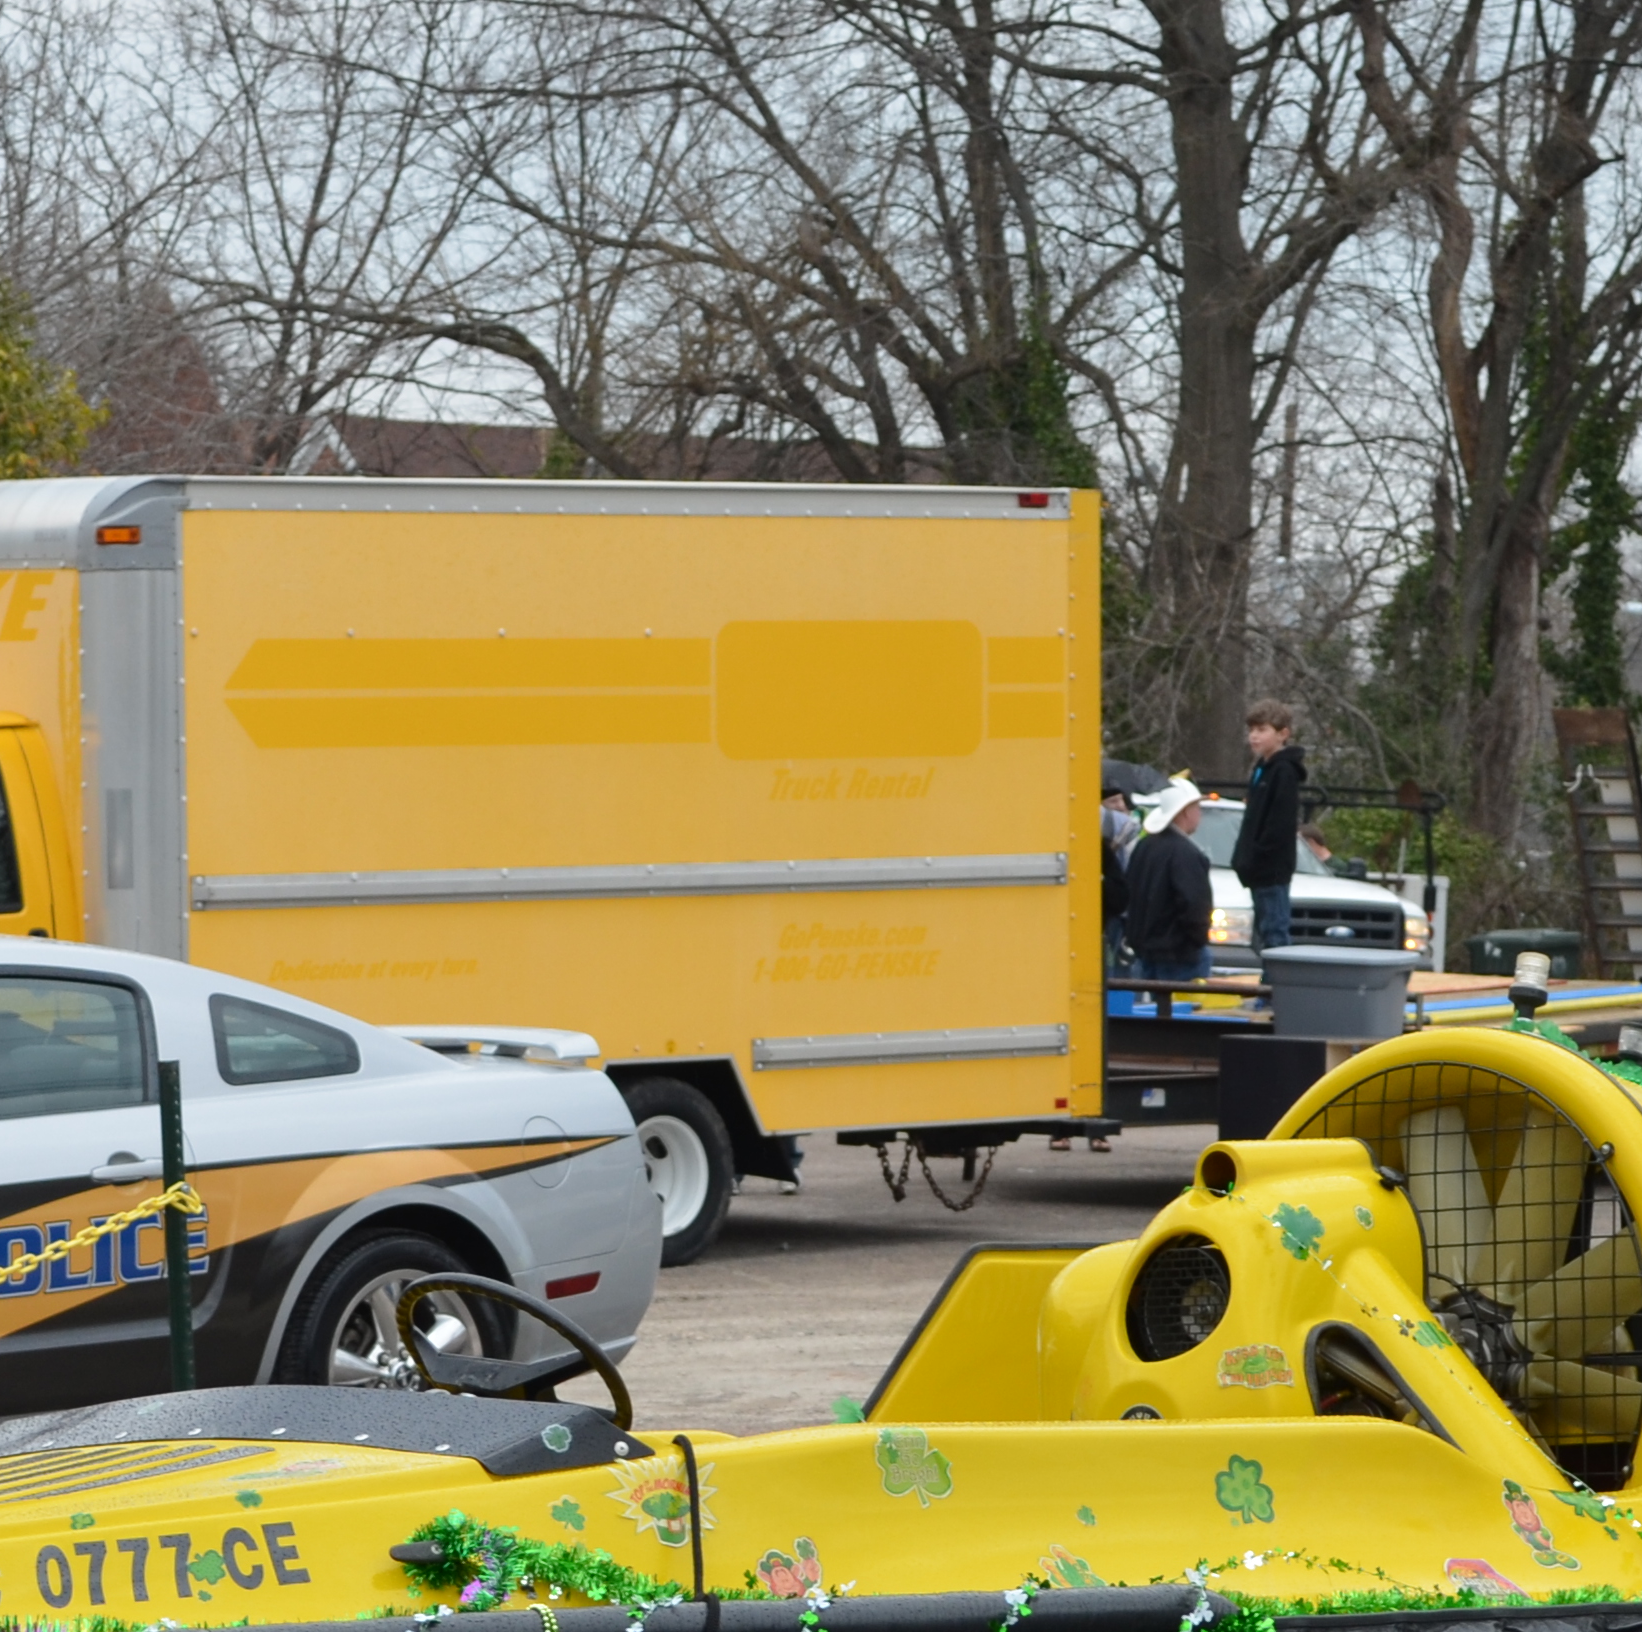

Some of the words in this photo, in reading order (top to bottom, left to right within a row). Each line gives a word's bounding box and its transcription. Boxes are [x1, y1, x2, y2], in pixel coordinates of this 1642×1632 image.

[769, 767, 845, 800] Truck
[846, 766, 937, 800] Rental
[778, 919, 928, 951] GoPenske.com
[35, 1533, 195, 1609] 0777
[222, 1521, 311, 1590] CE
